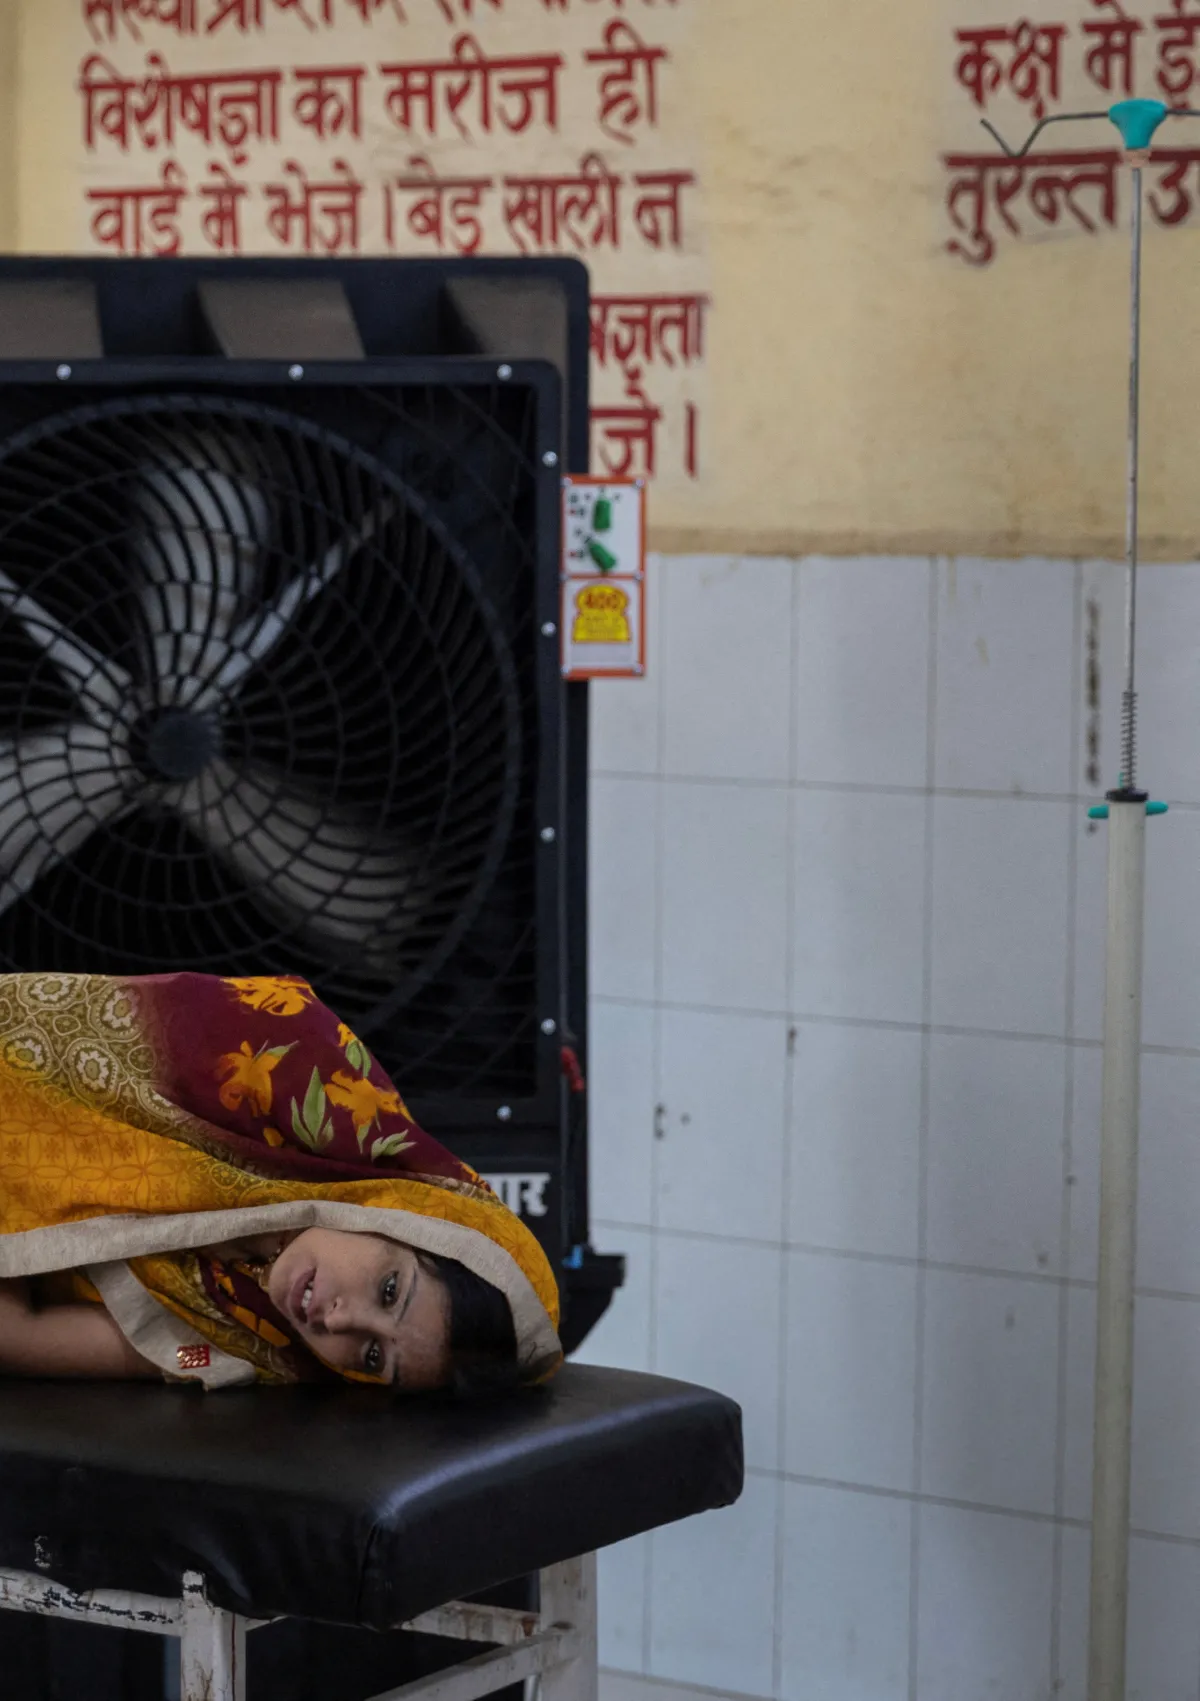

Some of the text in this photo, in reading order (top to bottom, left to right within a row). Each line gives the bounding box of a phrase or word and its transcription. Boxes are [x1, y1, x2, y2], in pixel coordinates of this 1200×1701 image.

[291, 64, 368, 145] का
[377, 31, 567, 141] मरीज
[955, 19, 1067, 121] कक्ष
[503, 152, 623, 256] खाली
[633, 169, 695, 250] न
[943, 148, 1124, 267] तुरन्त
